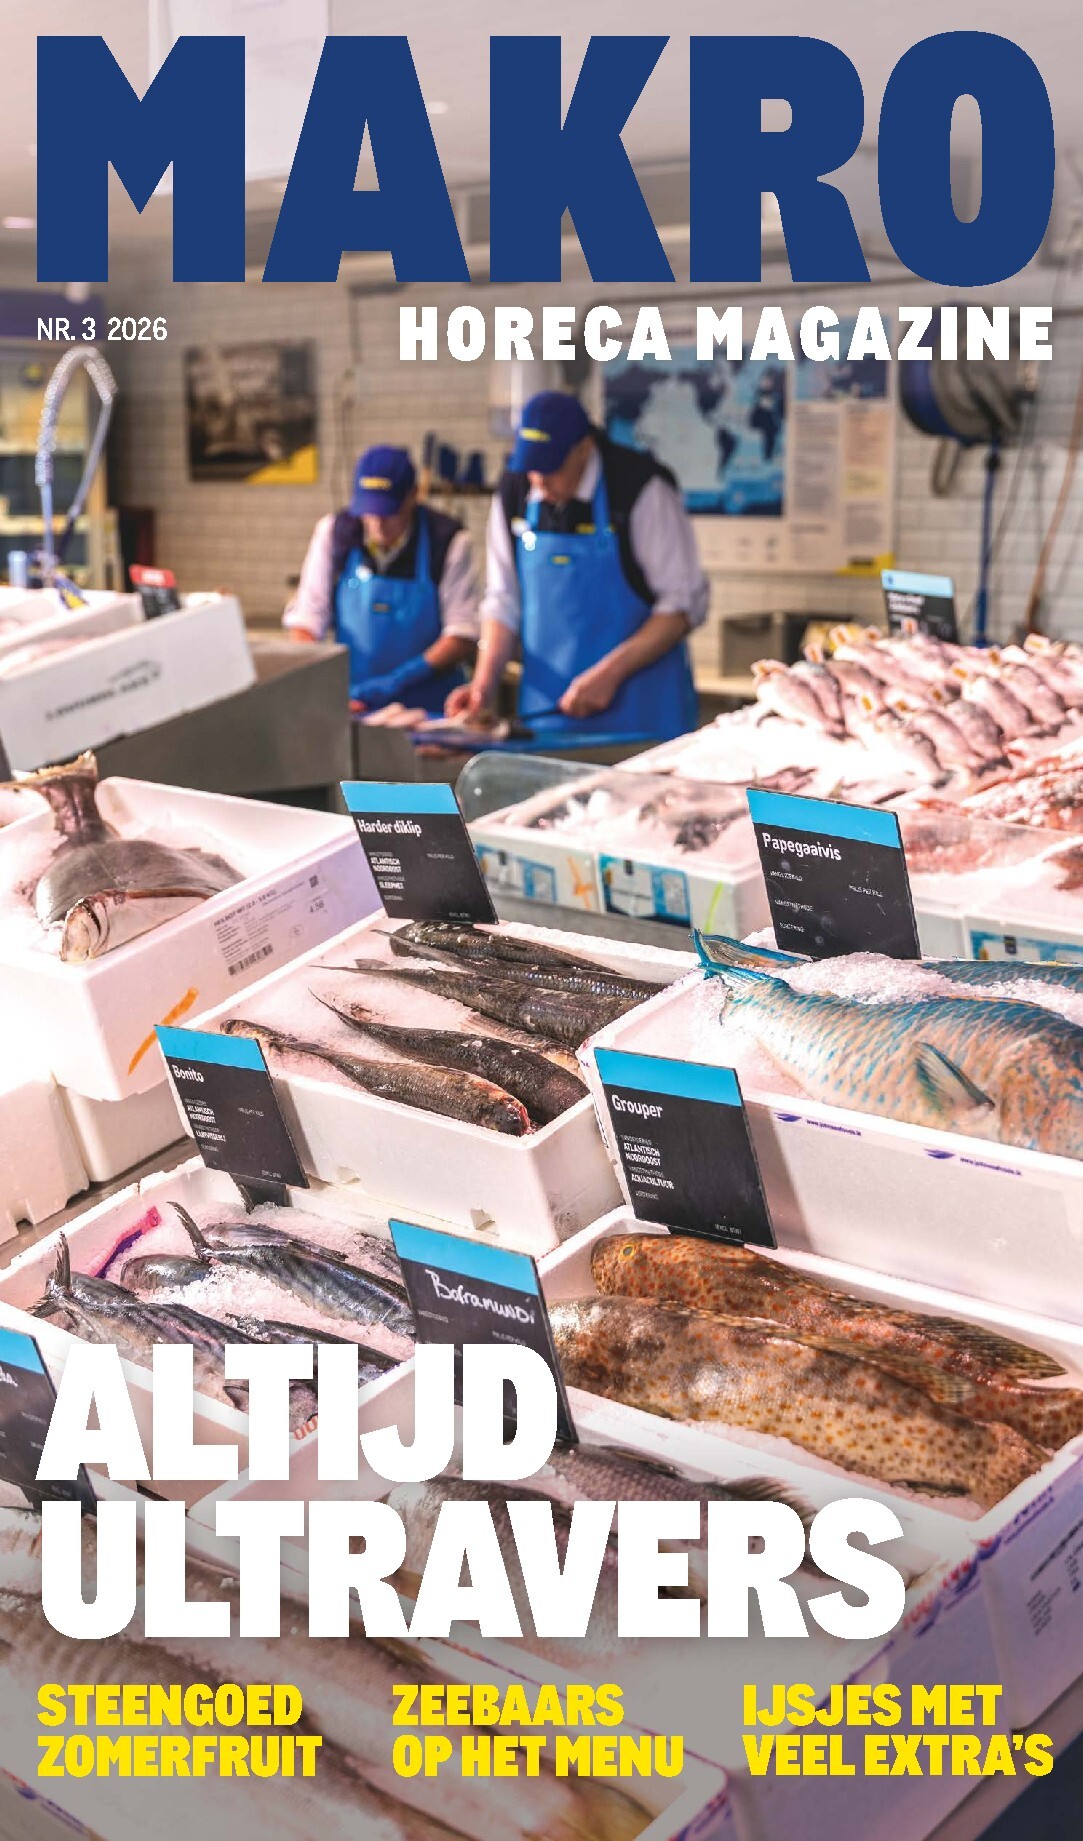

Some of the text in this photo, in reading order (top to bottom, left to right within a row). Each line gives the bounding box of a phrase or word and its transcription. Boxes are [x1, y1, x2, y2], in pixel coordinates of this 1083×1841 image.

[356, 818, 423, 837] Harder diklip
[761, 832, 843, 861] Papegaaivis
[171, 1064, 205, 1083] Bonito
[611, 1094, 664, 1120] Grouper
